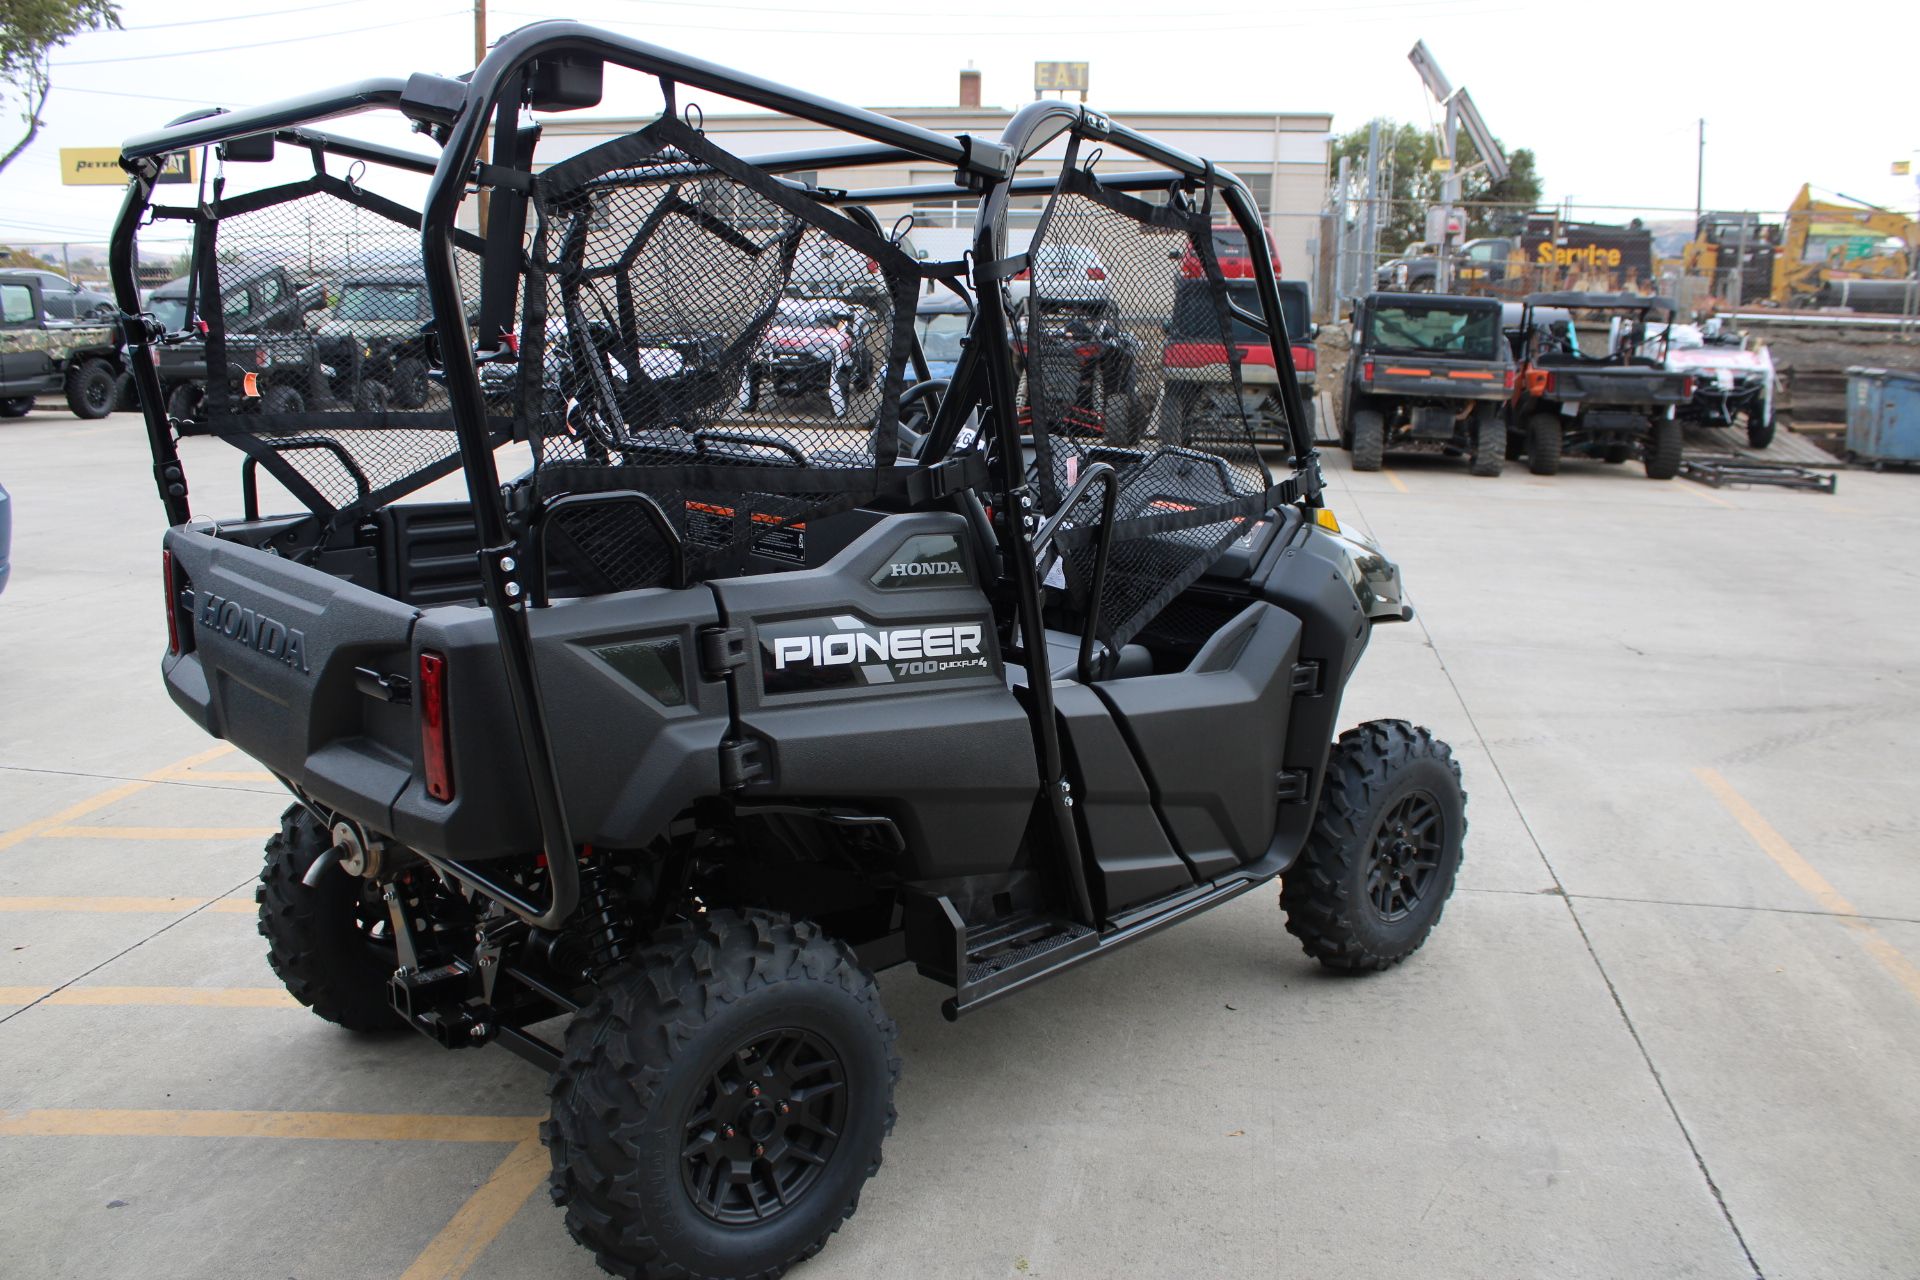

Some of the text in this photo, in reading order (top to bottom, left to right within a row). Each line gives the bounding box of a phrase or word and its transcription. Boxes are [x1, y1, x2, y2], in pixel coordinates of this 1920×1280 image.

[1037, 63, 1087, 87] EAT
[76, 160, 119, 173] PETER
[160, 154, 186, 174] AT
[1536, 242, 1622, 267] Service
[890, 561, 964, 577] HONDA
[199, 591, 310, 674] HONDA
[774, 625, 982, 669] PIONEER
[895, 660, 938, 676] 700
